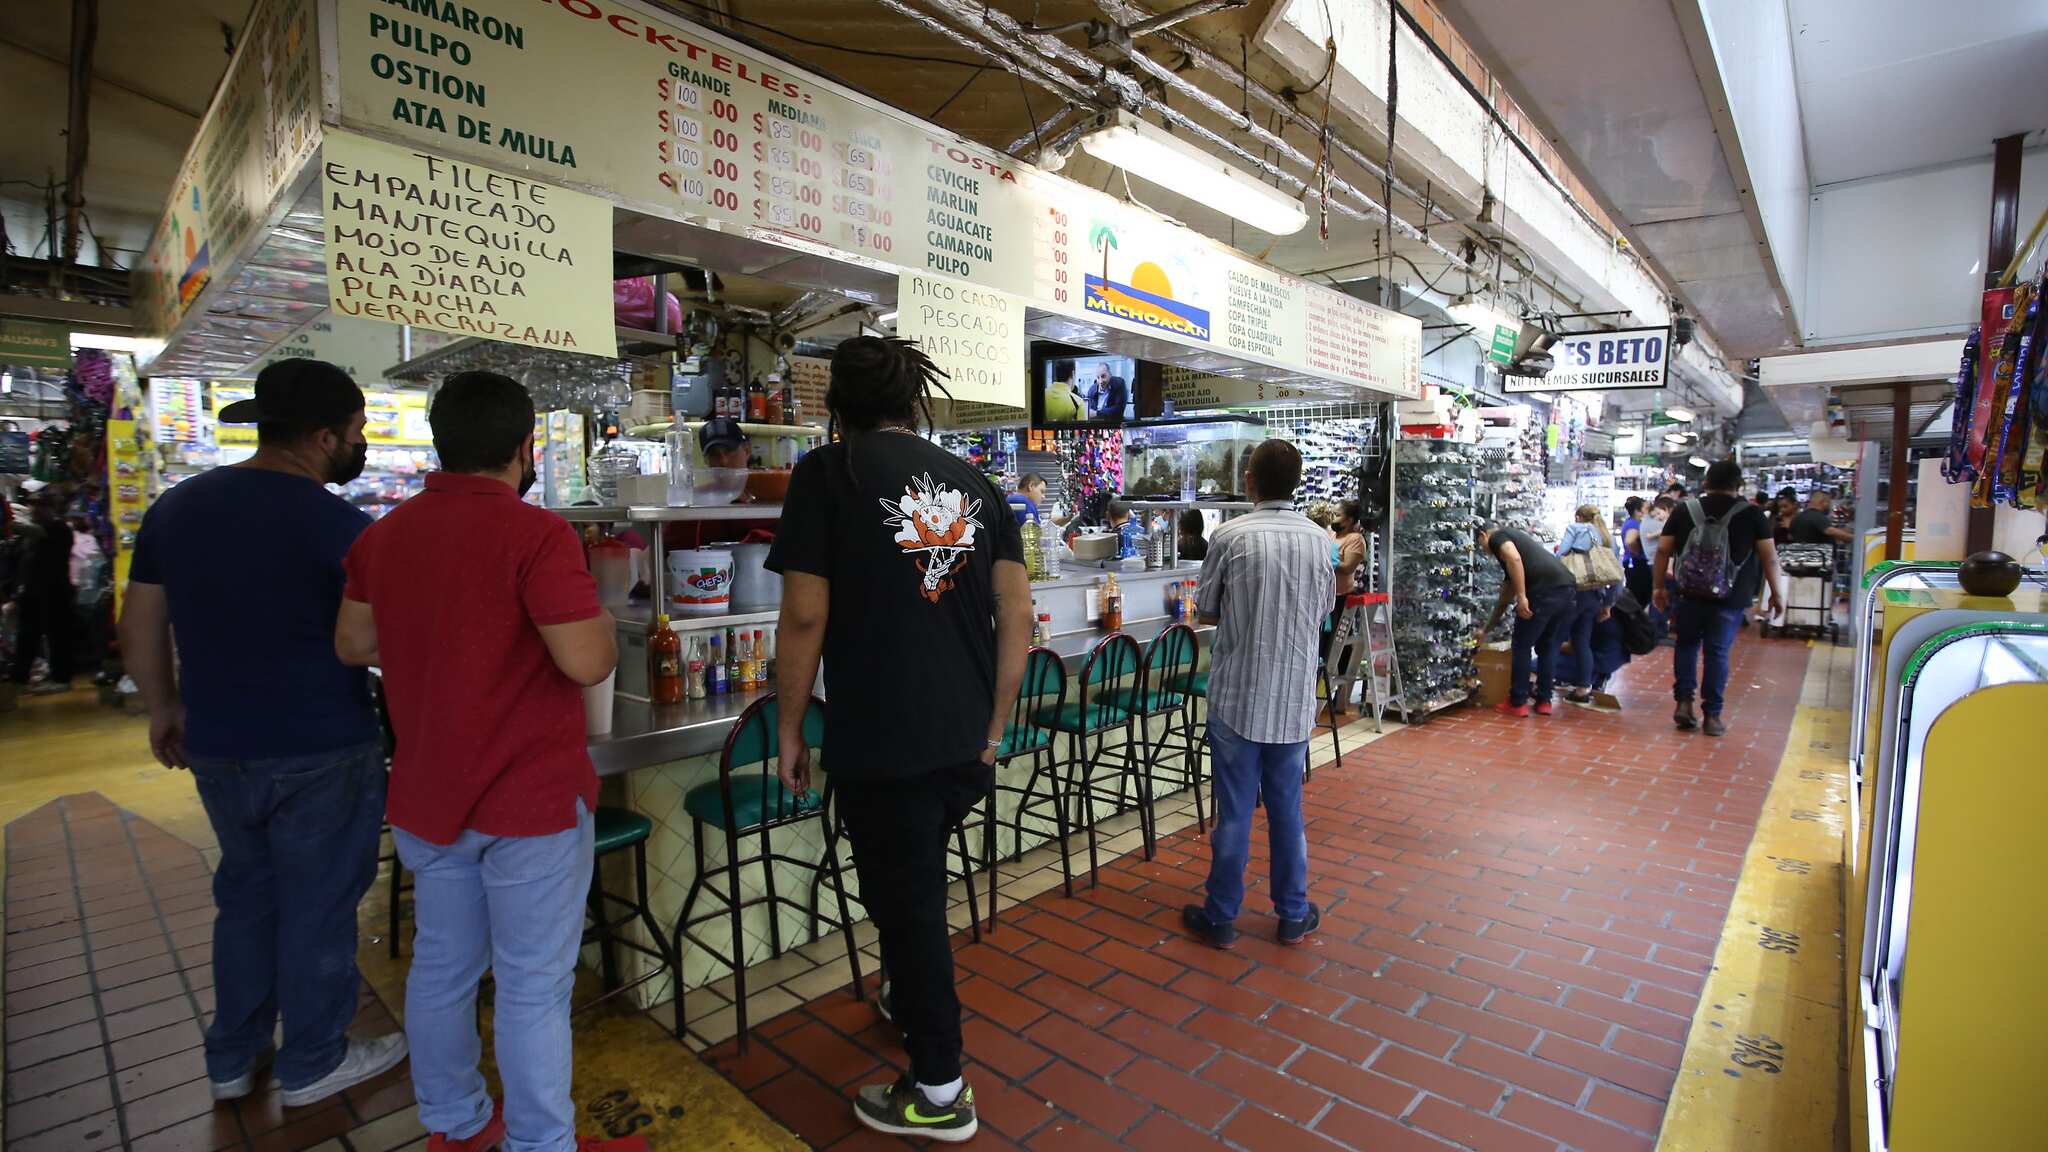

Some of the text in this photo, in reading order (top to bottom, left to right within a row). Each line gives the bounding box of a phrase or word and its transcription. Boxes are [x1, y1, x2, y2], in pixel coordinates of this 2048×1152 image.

[370, 13, 471, 66] PULPO
[378, 0, 523, 49] MARON
[542, 0, 812, 104] OCKTELES:
[371, 53, 486, 107] OSTION
[668, 61, 731, 97] GRANDE
[458, 115, 491, 145] DE
[500, 128, 577, 168] MULA
[413, 154, 547, 204] FILETE
[927, 165, 979, 196] CEVICHE
[326, 162, 555, 233] EMPANIZADO
[927, 186, 978, 217] MARLIN
[333, 192, 573, 266] MANTEQUILLA
[927, 208, 992, 242] AGUACATE
[428, 244, 470, 268] DE
[927, 230, 992, 263] CAMARON
[410, 264, 526, 297] DIABLA
[927, 251, 970, 277] PULPO
[342, 277, 497, 316] PLANCHA
[913, 277, 1007, 312] RICO CALDO
[1228, 270, 1290, 300] CALDO DE MARISCOS
[1228, 281, 1251, 299] VUELVE
[1268, 296, 1283, 310] VIDA
[336, 298, 577, 347] VERACRUZANA
[920, 305, 1008, 338] PESCADO
[1087, 295, 1209, 338] MICHOACAN
[1228, 296, 1271, 318] CAMPECHANA
[1228, 309, 1267, 330] COPA TRIPLE
[1228, 322, 1282, 347] COPA CUADRUPLE
[1228, 336, 1246, 349] COPA
[1598, 336, 1662, 365] BETO
[1581, 370, 1659, 384] SUCURSALES
